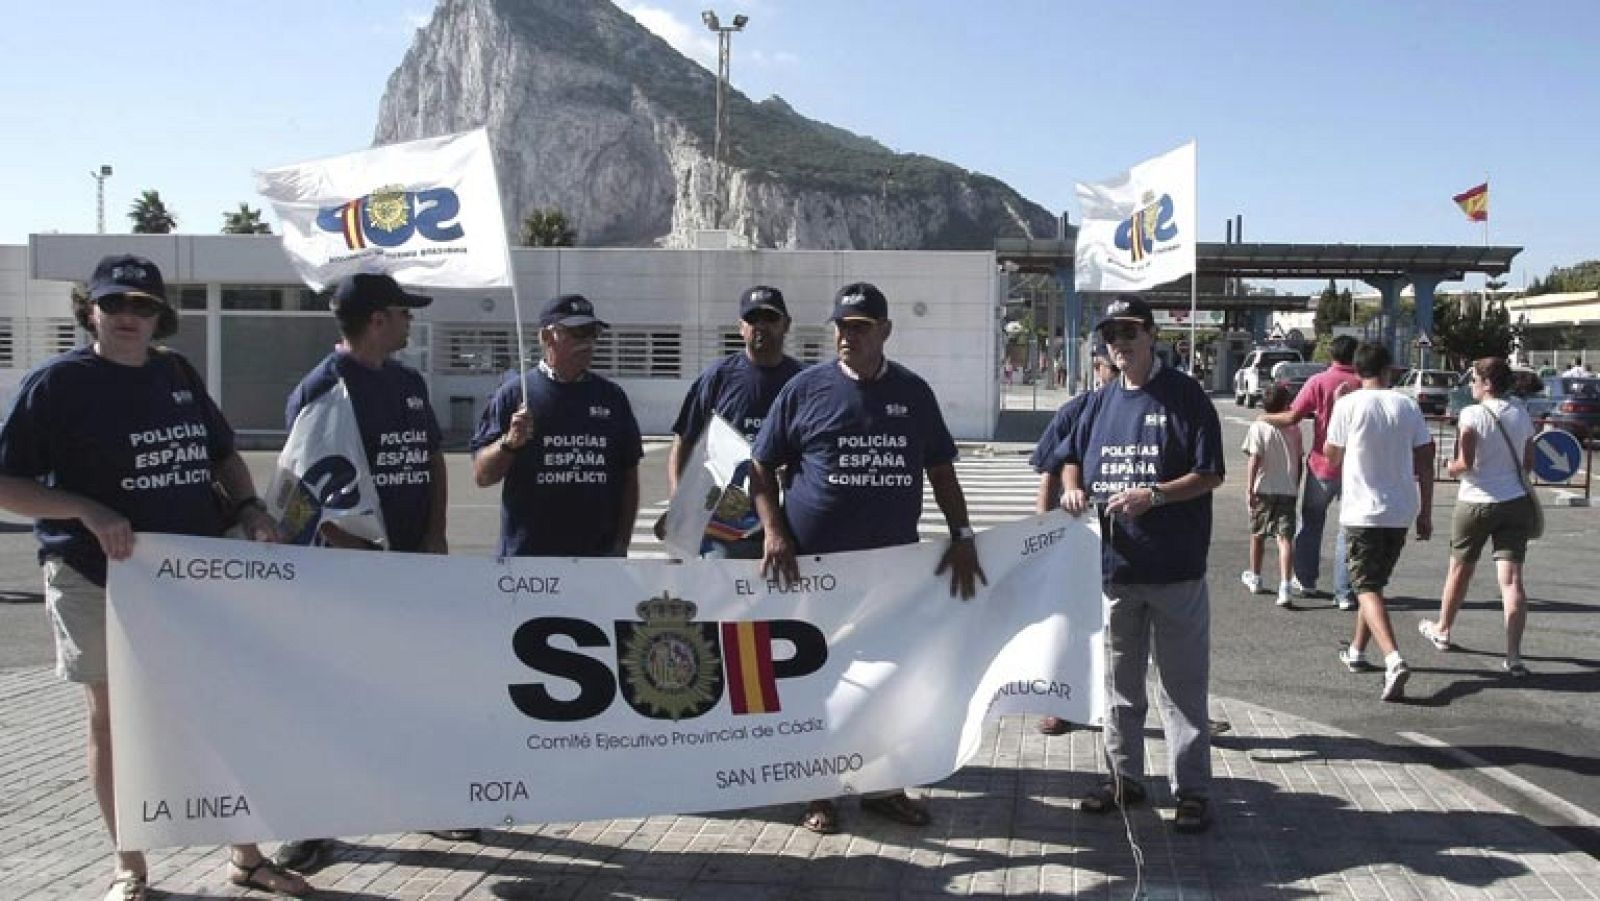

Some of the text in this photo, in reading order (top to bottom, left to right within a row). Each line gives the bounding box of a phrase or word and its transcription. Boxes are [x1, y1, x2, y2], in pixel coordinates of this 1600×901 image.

[543, 433, 608, 448] POLICÍAS
[838, 433, 908, 448] POLICÍAS
[135, 442, 209, 469] ESPAÑA
[543, 449, 606, 467] ESPAÑA
[839, 452, 906, 468] ESPAÑA
[1101, 460, 1158, 475] ESPAÑA
[828, 474, 914, 487] CONFLICTO
[156, 558, 296, 581] ALGECIRAS
[497, 575, 561, 595] CADIZ
[734, 579, 756, 596] EL
[507, 615, 828, 722] SUP
[526, 717, 825, 751] Comité Ejecutivo Provincial de Cádiz
[715, 752, 865, 790] SAN FERNANDO
[469, 779, 531, 802] ROTA
[142, 794, 251, 822] LA LINEA
